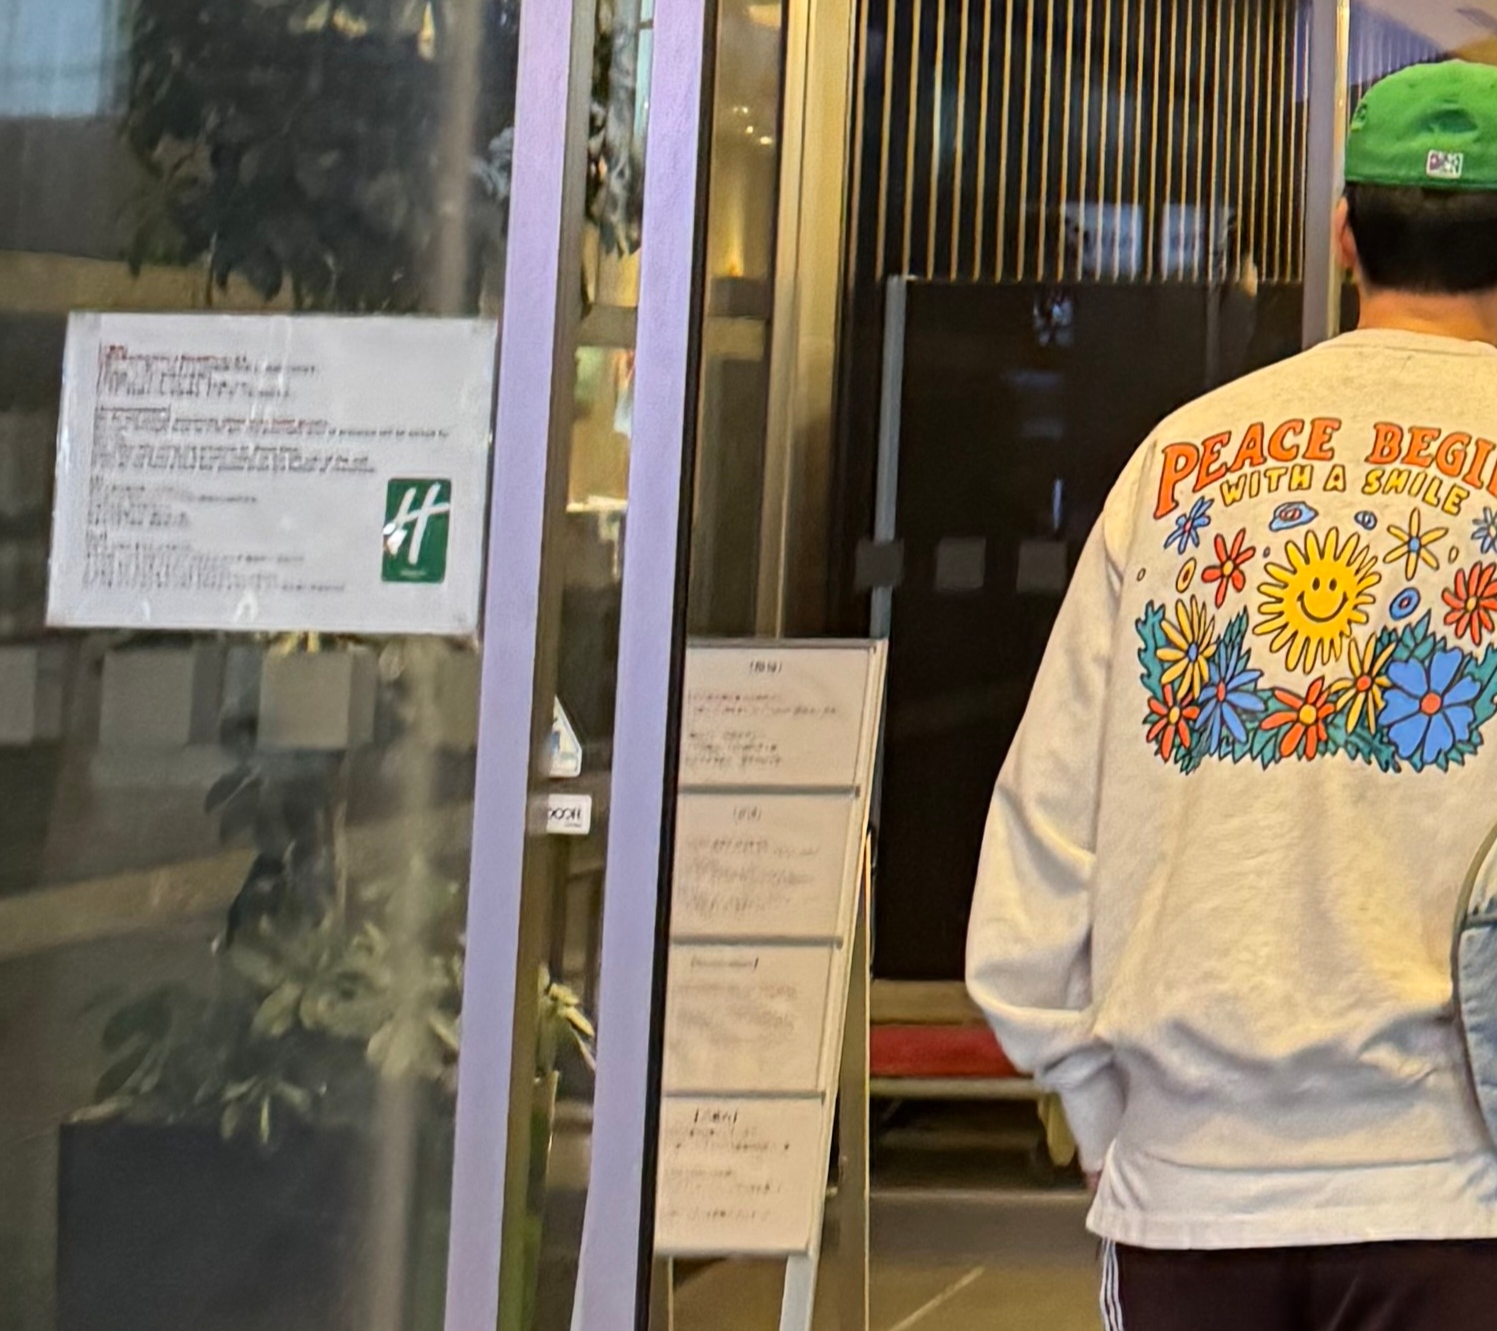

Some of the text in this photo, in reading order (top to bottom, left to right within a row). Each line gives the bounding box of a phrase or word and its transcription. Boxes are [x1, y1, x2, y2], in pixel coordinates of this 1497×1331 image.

[1153, 416, 1343, 520] PEACE
[1219, 463, 1470, 517] WITH A SMILE
